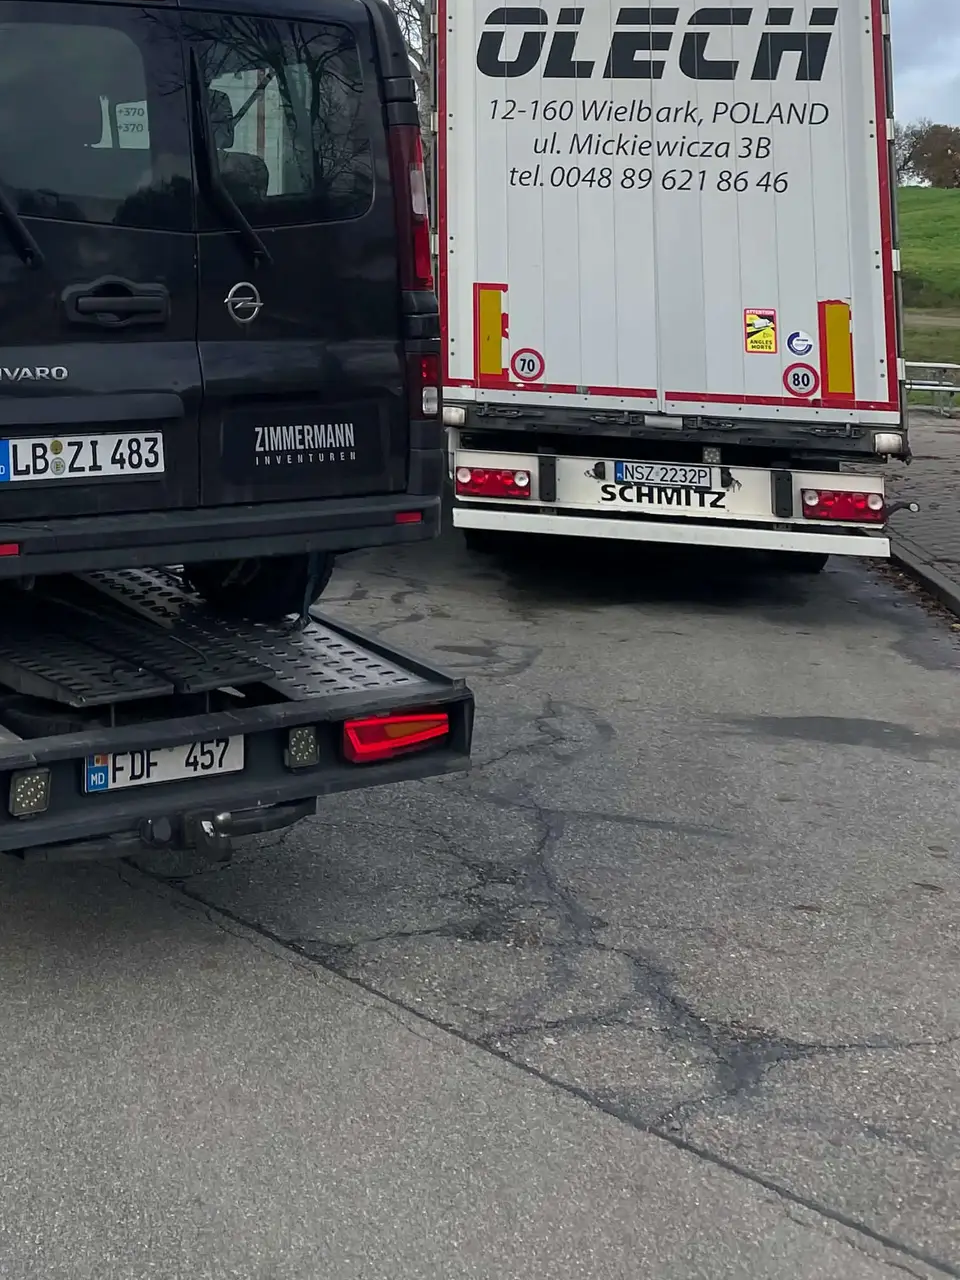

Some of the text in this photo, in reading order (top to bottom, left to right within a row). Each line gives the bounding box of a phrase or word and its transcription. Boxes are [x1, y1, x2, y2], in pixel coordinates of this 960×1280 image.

[476, 7, 838, 81] OLECH
[490, 99, 829, 127] 12-160 Wielbark, POLAND
[533, 131, 772, 159] ul. Mickiewicza 3B
[509, 164, 789, 194] tel. 0048 89 621 86 46
[520, 358, 535, 372] 70
[792, 373, 810, 387] 80
[254, 423, 355, 452] ZIMMERMANN
[12, 437, 159, 476] LB ZI 483
[255, 451, 356, 466] INVENTUREN
[624, 464, 708, 484] NSZ 2232P
[601, 484, 726, 509] SCHMITZ
[185, 736, 230, 772] 457
[91, 772, 105, 786] MD
